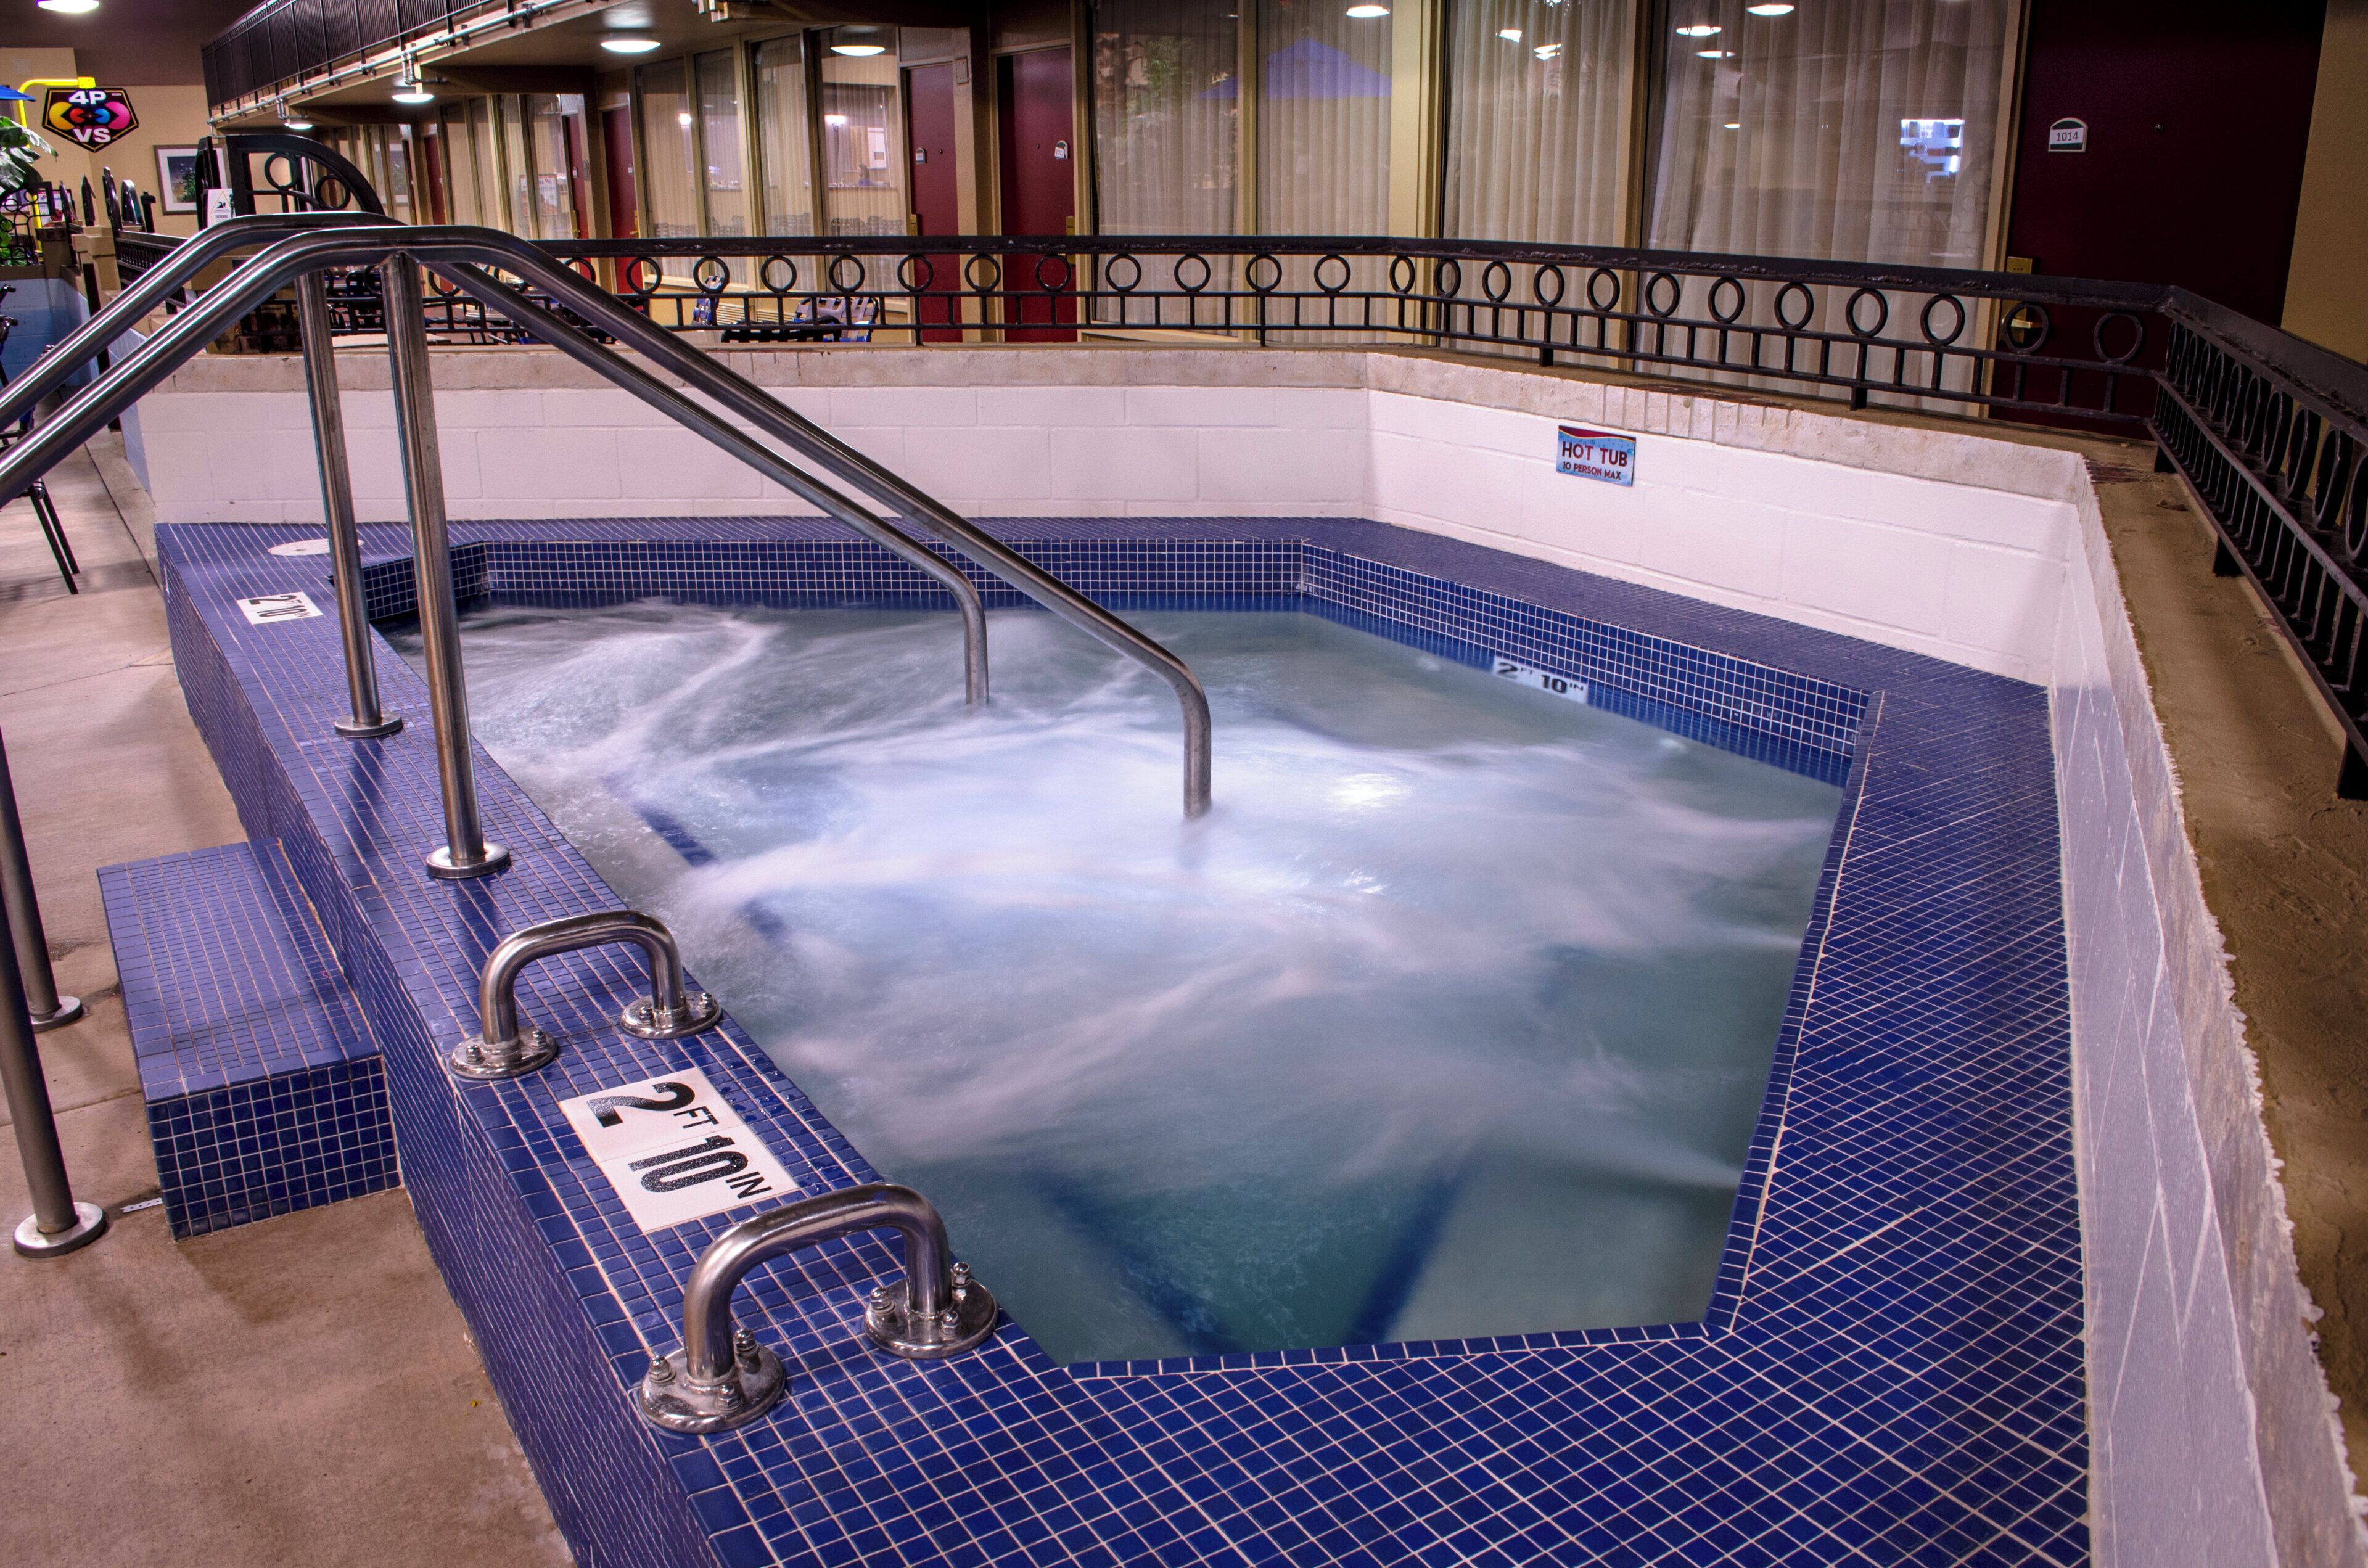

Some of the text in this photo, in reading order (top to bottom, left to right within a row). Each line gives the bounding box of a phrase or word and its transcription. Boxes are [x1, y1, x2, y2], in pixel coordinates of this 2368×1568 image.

[68, 91, 106, 105] 4P
[73, 128, 111, 143] VS
[2056, 131, 2078, 142] 1014
[1562, 441, 1627, 467] HOT TUB
[1563, 461, 1621, 480] 10 PERSON MAX
[1498, 662, 1518, 679] 2
[1542, 675, 1567, 694] 10
[586, 1082, 773, 1199] 2 FT 10 IN
